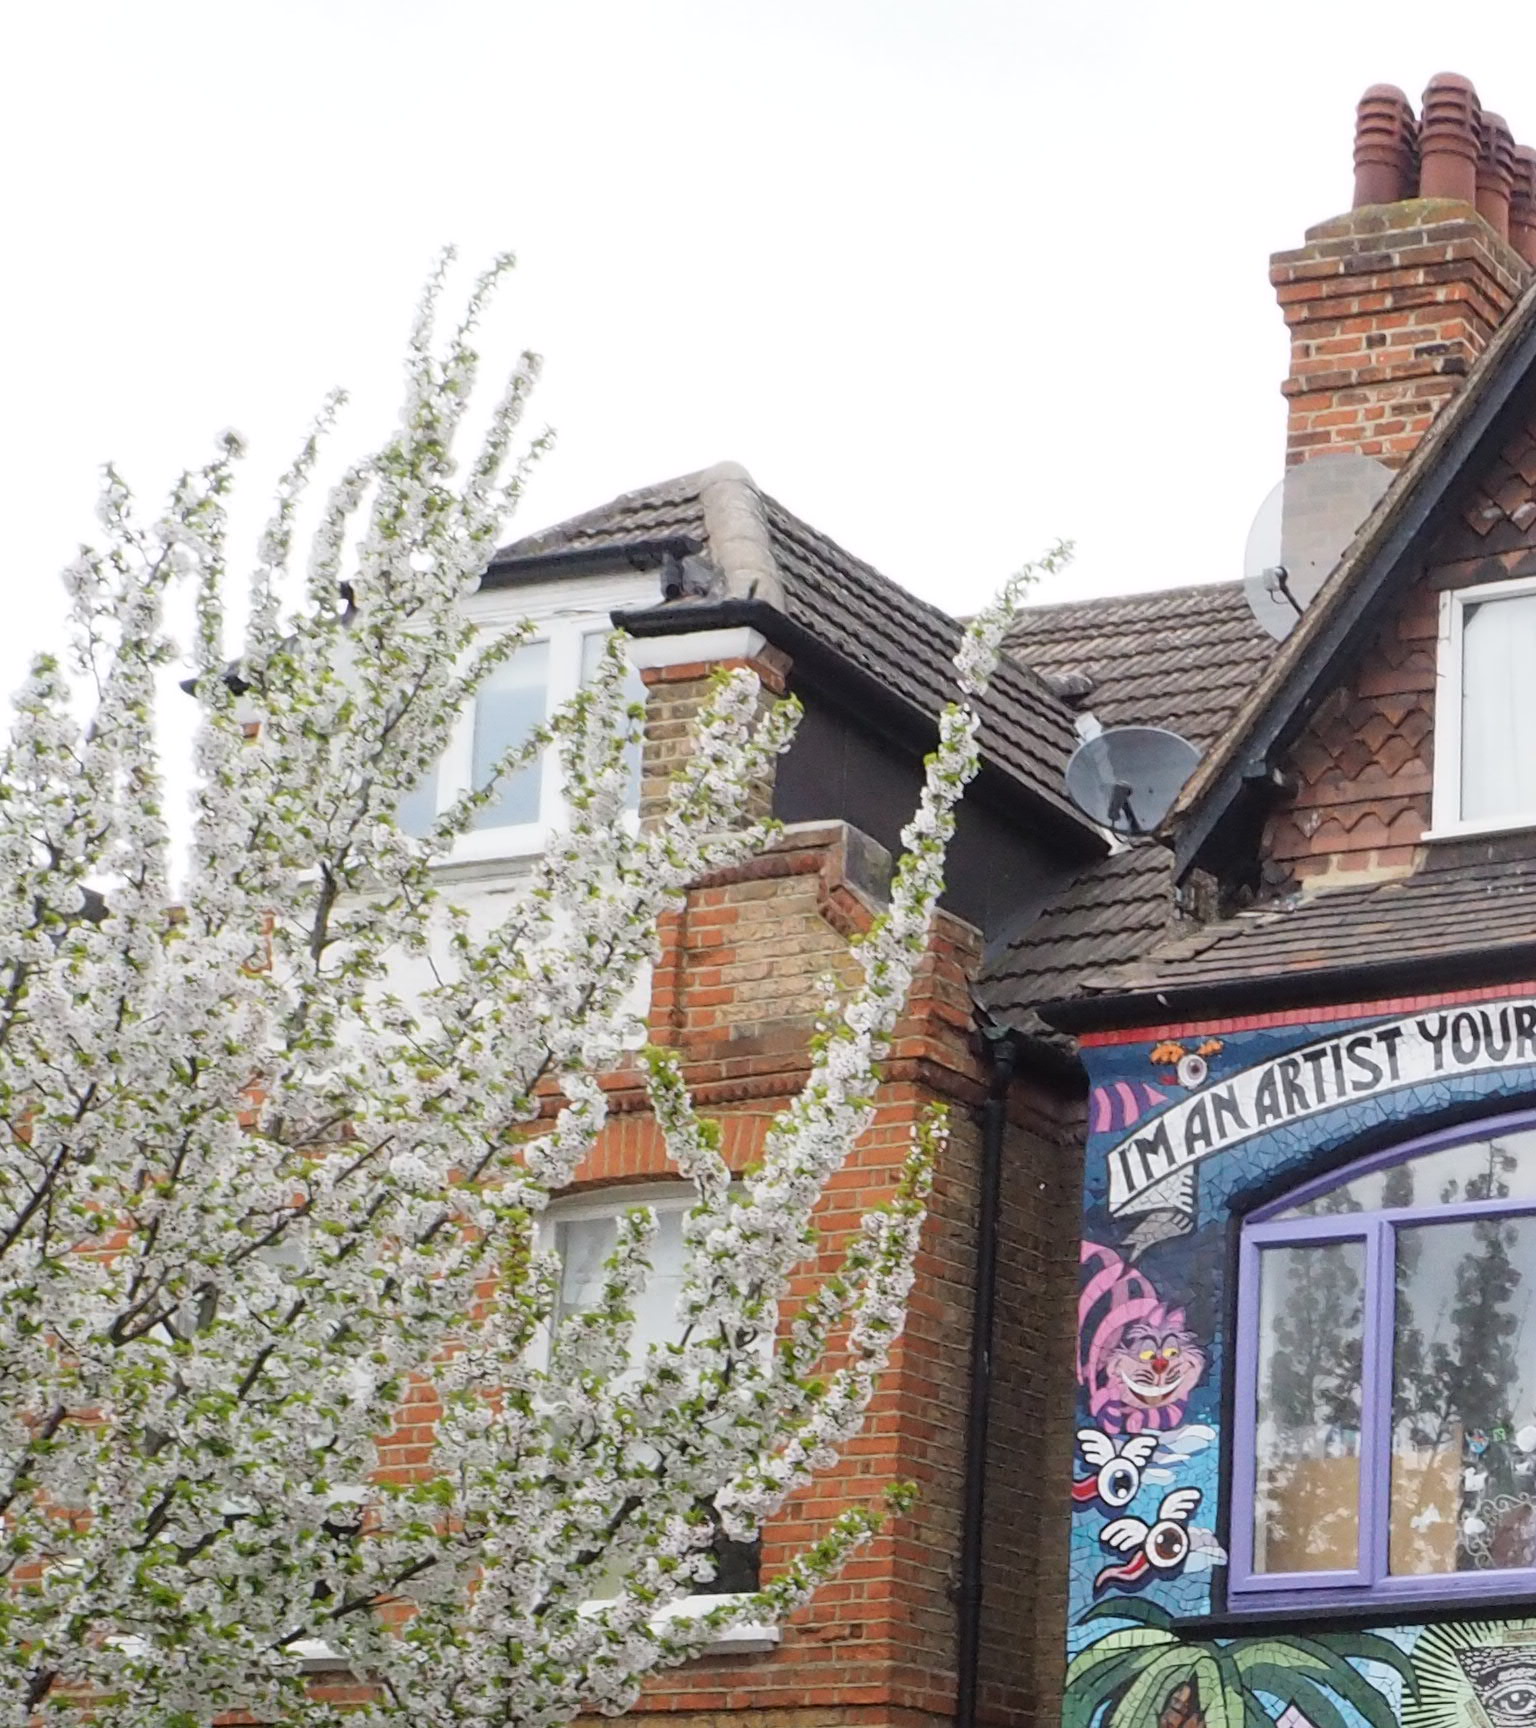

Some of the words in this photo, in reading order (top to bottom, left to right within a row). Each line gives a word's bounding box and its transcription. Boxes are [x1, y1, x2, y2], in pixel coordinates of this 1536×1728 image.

[1117, 1115, 1177, 1194] I'M
[1184, 1083, 1247, 1156] AN
[1253, 1027, 1403, 1129] ARTIST
